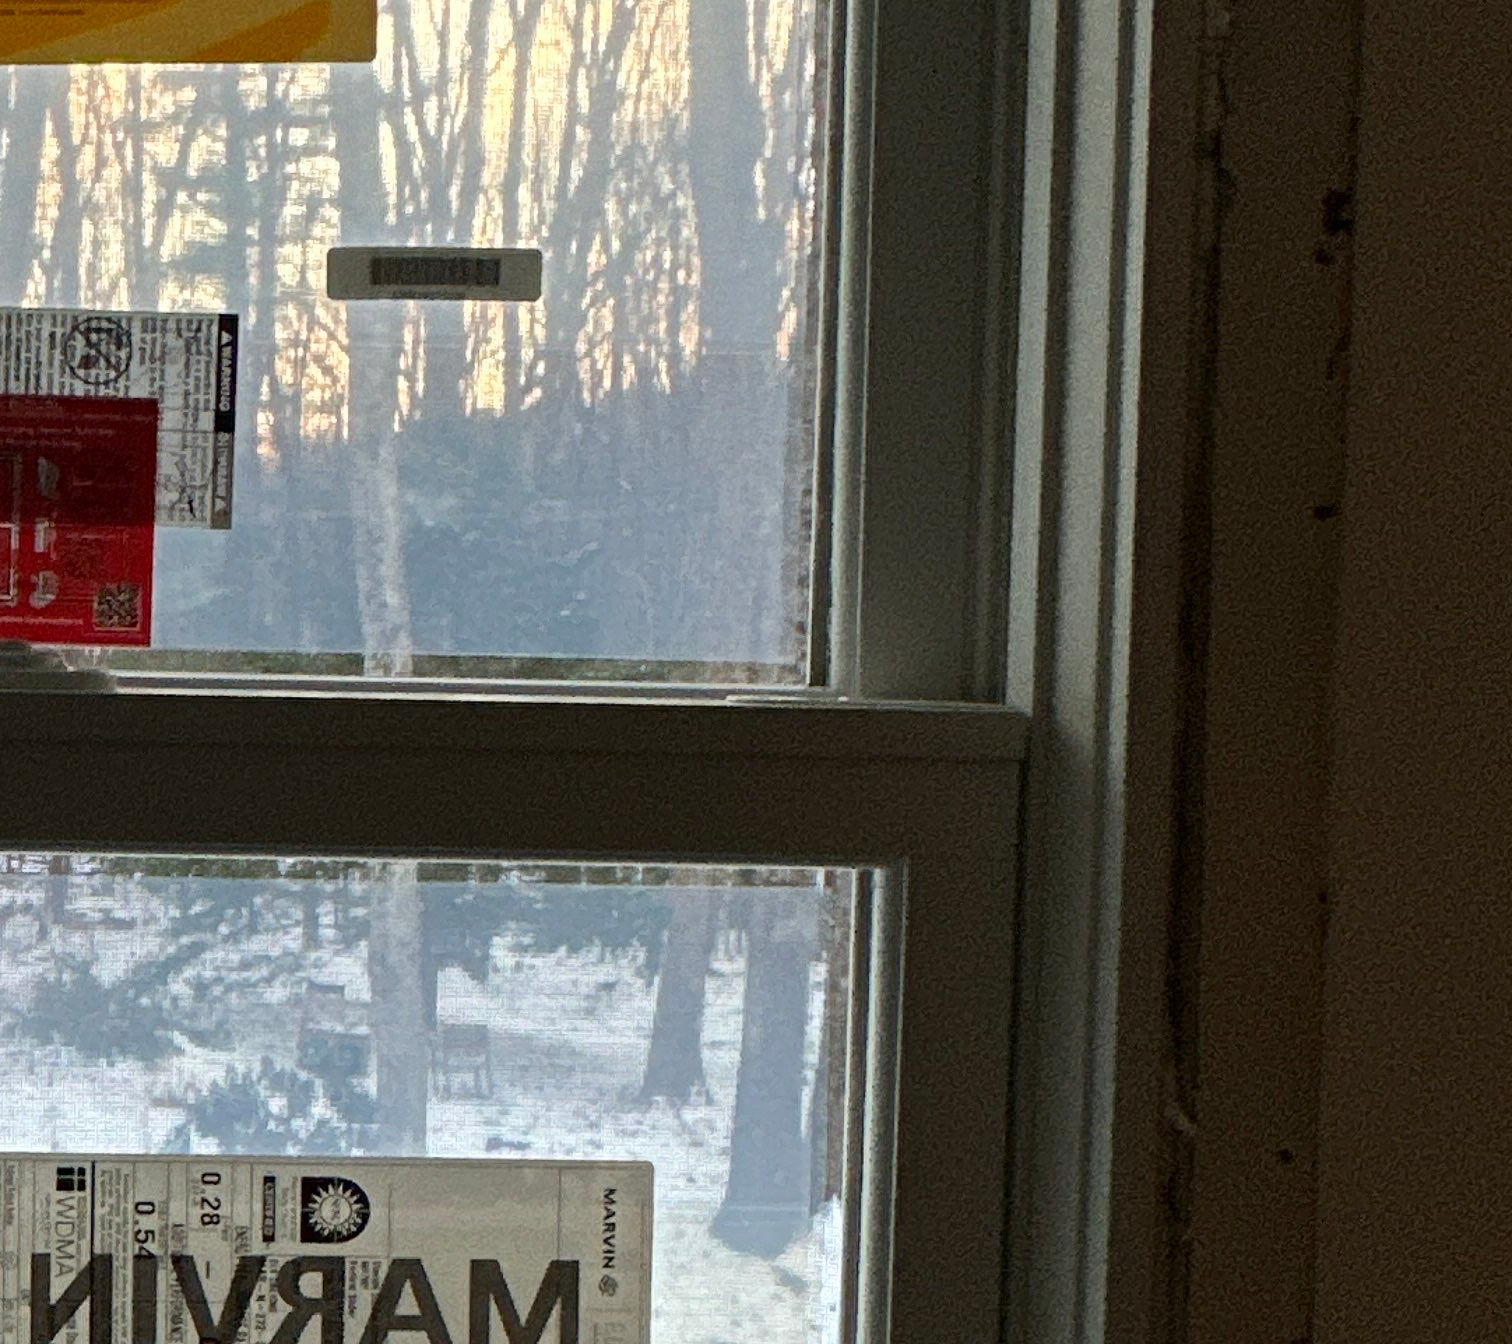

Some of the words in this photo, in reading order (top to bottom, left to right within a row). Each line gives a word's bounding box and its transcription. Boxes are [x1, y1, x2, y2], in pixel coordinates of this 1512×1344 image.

[134, 1201, 156, 1260] 0.54
[200, 1171, 221, 1227] 0.28
[602, 1188, 617, 1269] MARVIN
[55, 1196, 76, 1278] WDMA
